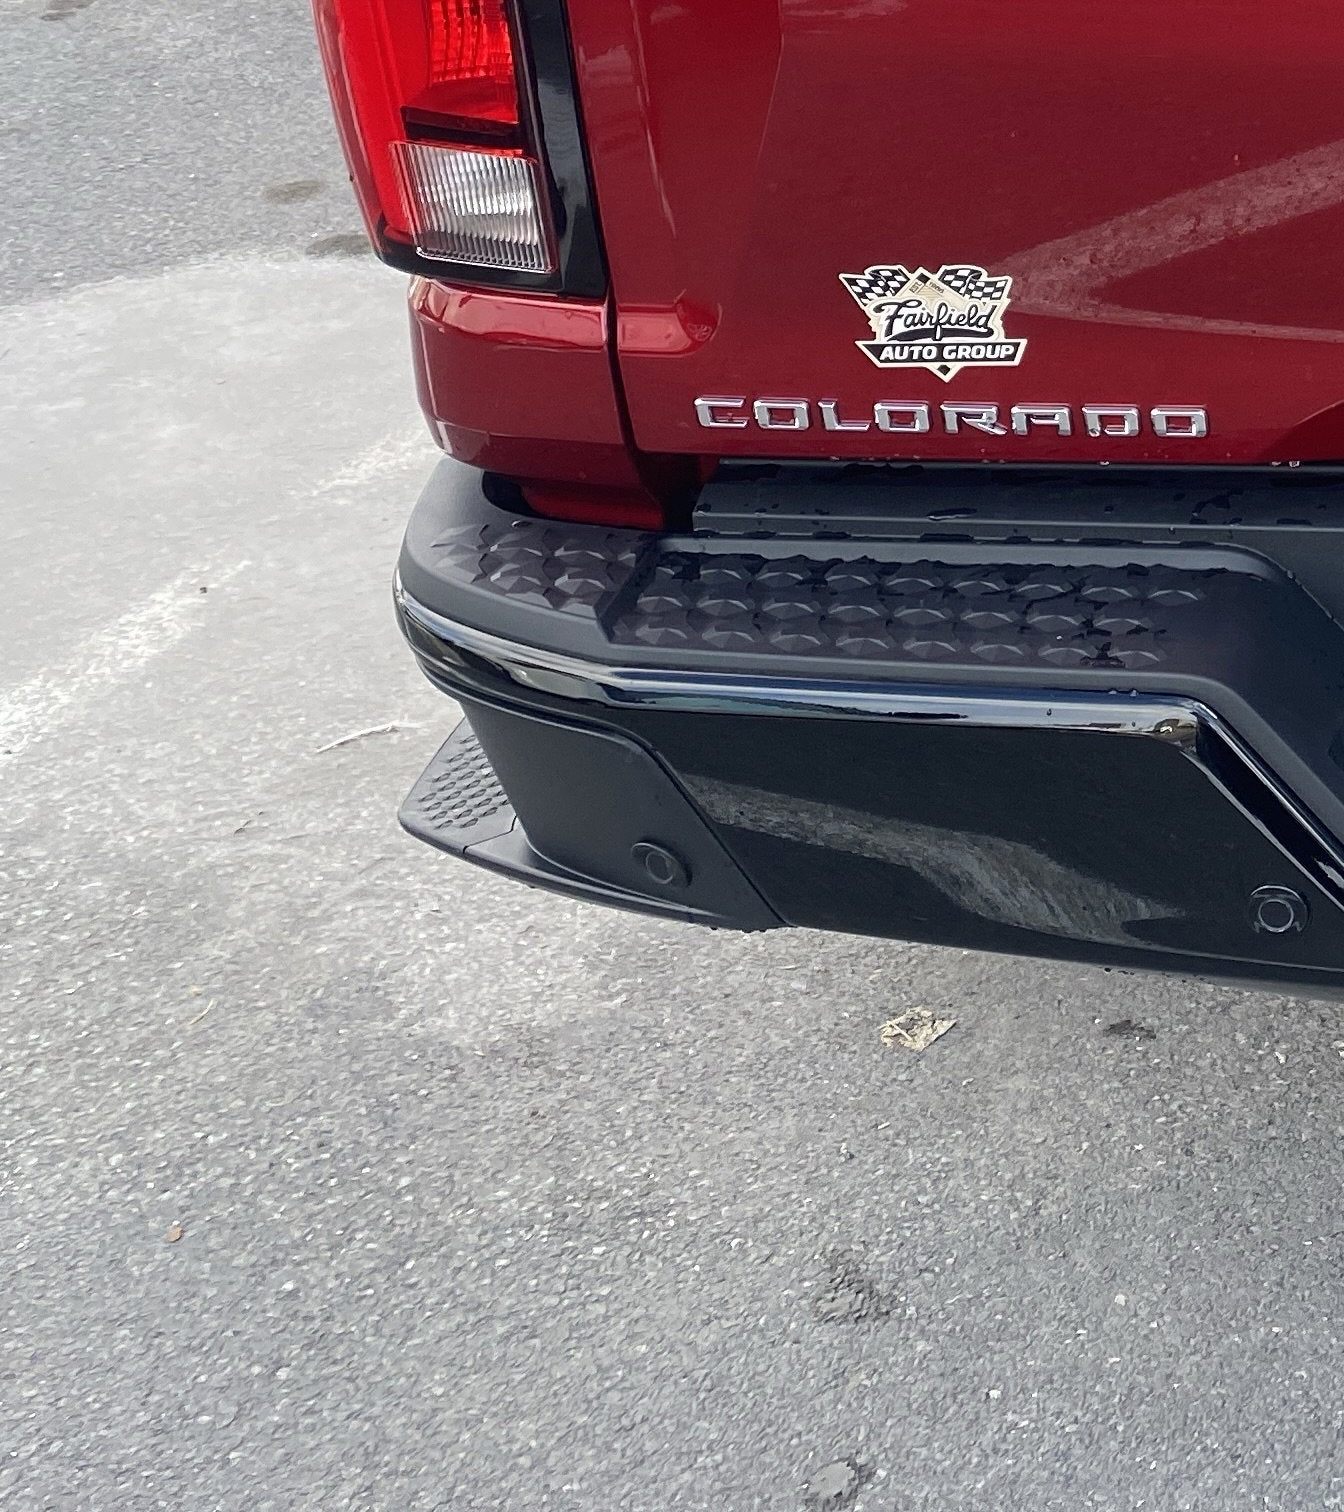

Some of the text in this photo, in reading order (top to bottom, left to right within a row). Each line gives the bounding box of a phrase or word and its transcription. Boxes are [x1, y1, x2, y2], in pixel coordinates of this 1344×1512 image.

[872, 299, 998, 339] Fairfield
[879, 344, 1015, 361] AUTO GROUP
[694, 396, 1208, 438] COLORADO
